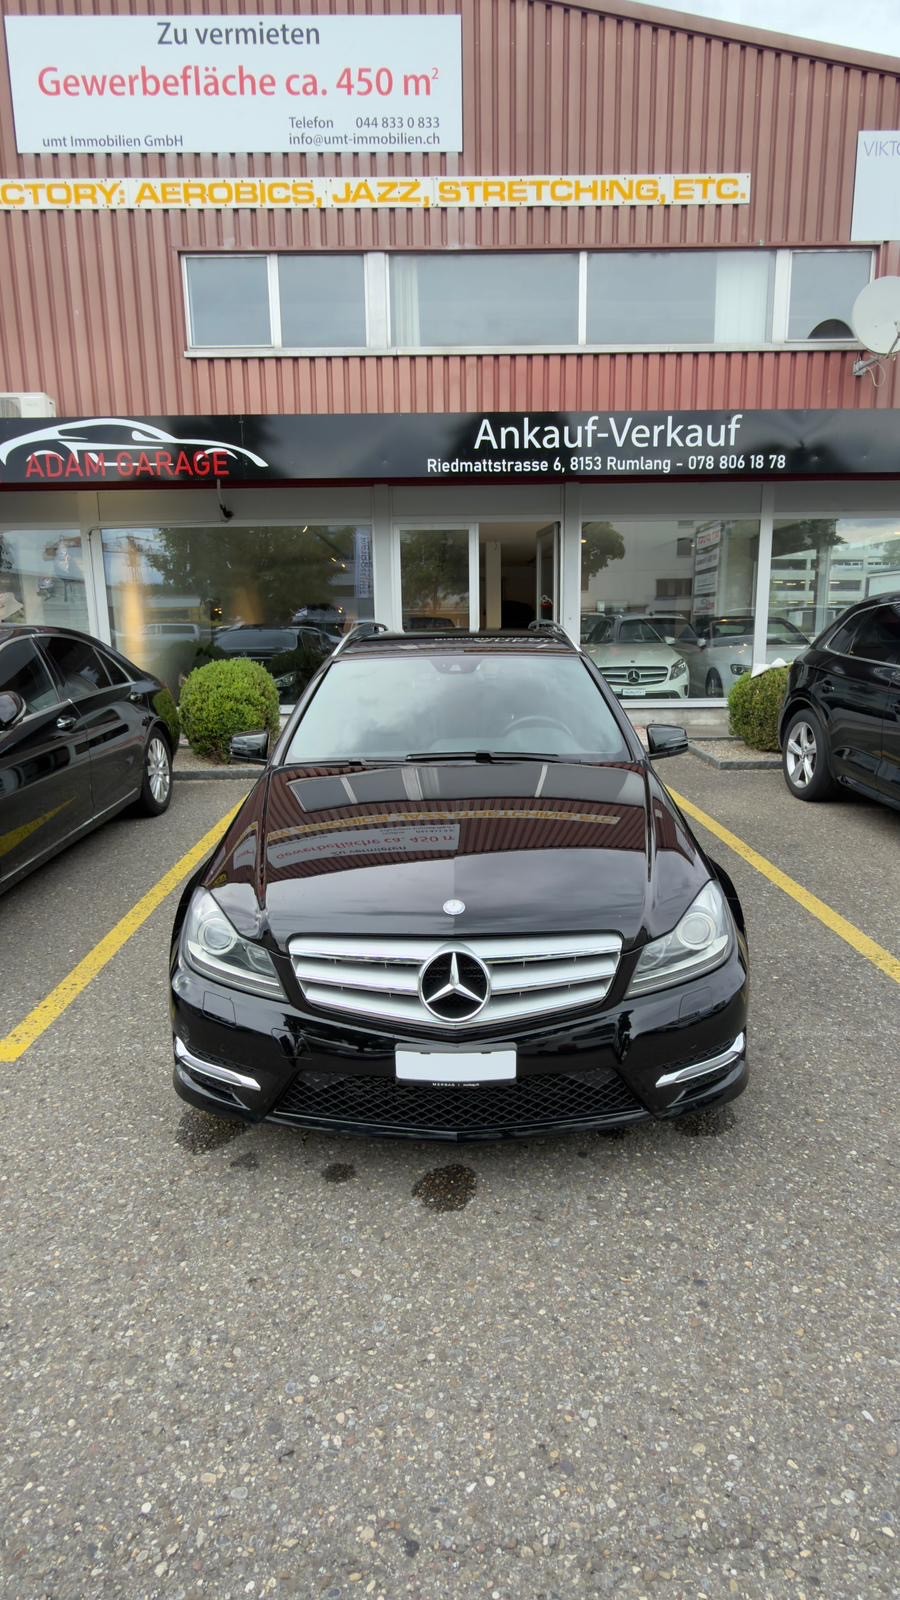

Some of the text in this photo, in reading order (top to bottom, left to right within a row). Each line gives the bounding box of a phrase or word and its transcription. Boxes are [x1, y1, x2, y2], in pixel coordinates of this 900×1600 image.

[157, 21, 320, 45] Zu vermieten
[38, 65, 276, 97] Gewerbefläche
[285, 73, 328, 97] ca.
[336, 67, 394, 97] 450
[288, 116, 440, 129] Telefon 044 833 0 833
[42, 134, 184, 147] umt Immobilien GmbH
[288, 132, 440, 147] info@umt-immobilien.ch
[863, 140, 900, 157] VIKT
[0, 178, 747, 208] CTORY: AEROBICS, JAZZ, STRETCHING, ETC.
[474, 414, 743, 450] Ankauf-Verkauf
[25, 450, 230, 478] ADAM GARAGE
[427, 457, 549, 473] Riedmattstrasse
[553, 456, 565, 473] 6,
[570, 455, 602, 471] 8153
[607, 455, 672, 474] Rumlang
[688, 455, 714, 470] 078
[719, 454, 746, 470] 806
[750, 454, 764, 469] 18
[769, 454, 786, 469] 78
